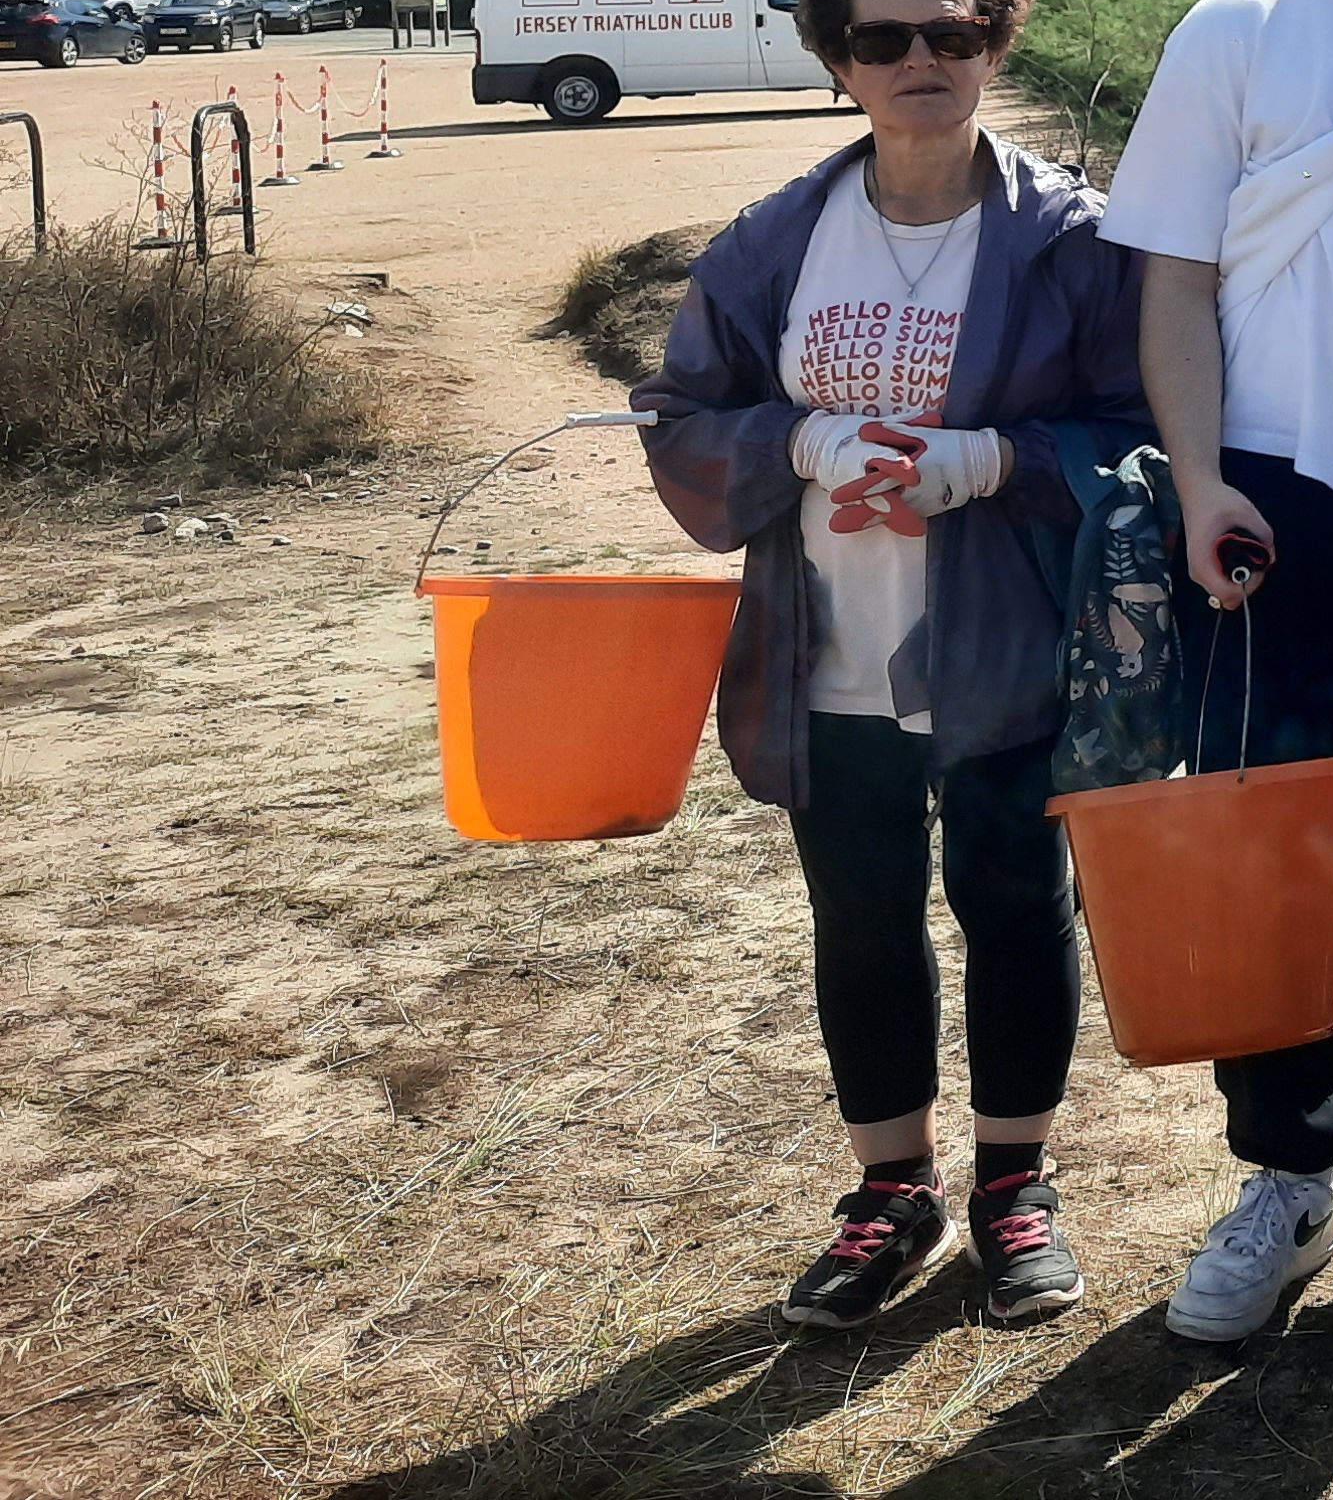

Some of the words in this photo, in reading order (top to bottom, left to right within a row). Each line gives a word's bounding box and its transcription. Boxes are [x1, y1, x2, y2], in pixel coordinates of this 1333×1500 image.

[515, 16, 577, 36] JERSEY
[583, 14, 682, 32] TRIATHLON
[690, 12, 733, 29] CLUB
[808, 300, 891, 330] HELLO
[804, 321, 887, 350] HELLO
[896, 324, 954, 348] SUM
[800, 341, 883, 372] HELLO
[892, 344, 951, 368] SUM
[799, 361, 880, 393] HELLO
[890, 364, 948, 390] SUM
[890, 385, 946, 410] SUM
